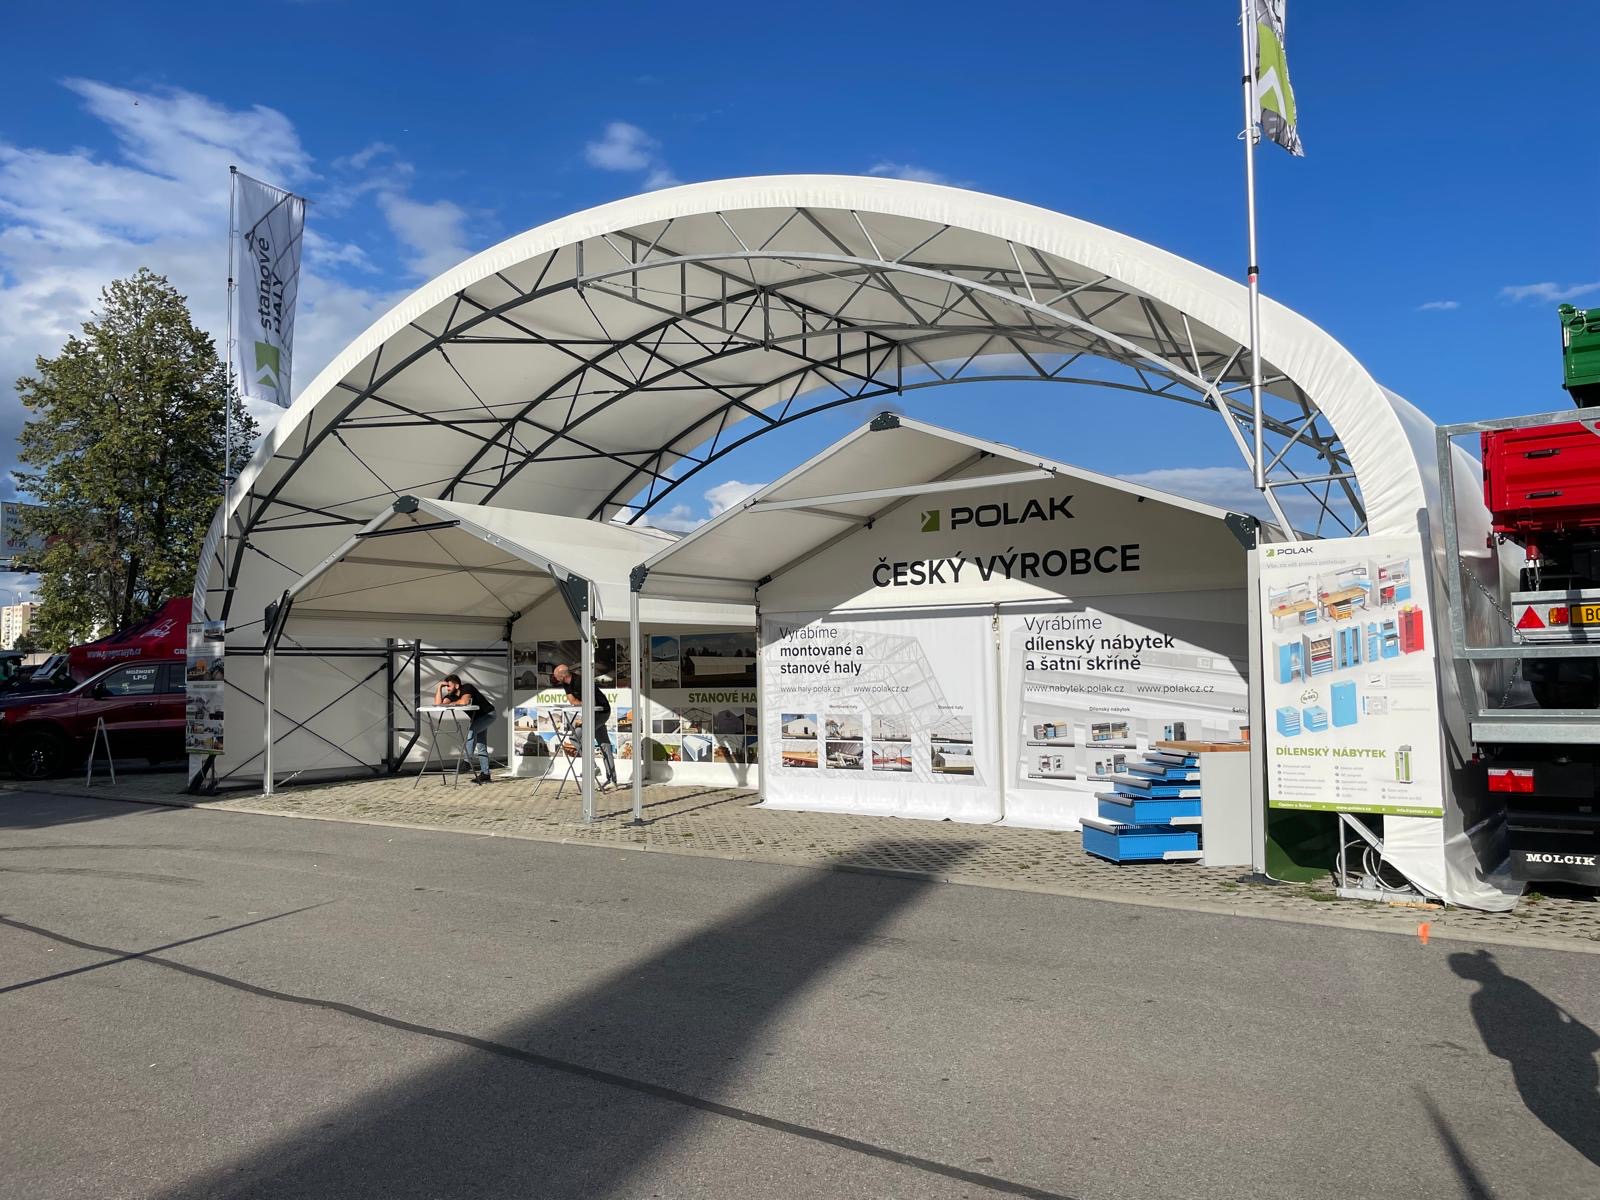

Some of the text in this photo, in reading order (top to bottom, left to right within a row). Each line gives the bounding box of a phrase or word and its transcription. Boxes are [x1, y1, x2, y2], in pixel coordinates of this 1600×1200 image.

[951, 495, 1075, 530] POLAK
[1277, 547, 1314, 555] POLAK
[872, 544, 1140, 588] ČESKÝ VÝROBCE
[1024, 615, 1102, 634] Vyrábíme
[780, 626, 838, 642] Vyrábíme
[780, 642, 864, 656] montované a
[1025, 634, 1175, 653] dílenský nábytek
[780, 660, 862, 676] stanové haly
[1025, 655, 1142, 670] a šatní skříně
[780, 684, 909, 693] www.haly-polak.cz www.polakcz.cz
[1137, 684, 1214, 694] www.polakcz.cz
[537, 693, 618, 703] MONTO LY
[688, 689, 757, 703] STANOVÉ HA
[1276, 745, 1387, 758] DÍLENSKÝ NÁBYTEK
[1525, 853, 1596, 866] MOLCIK
